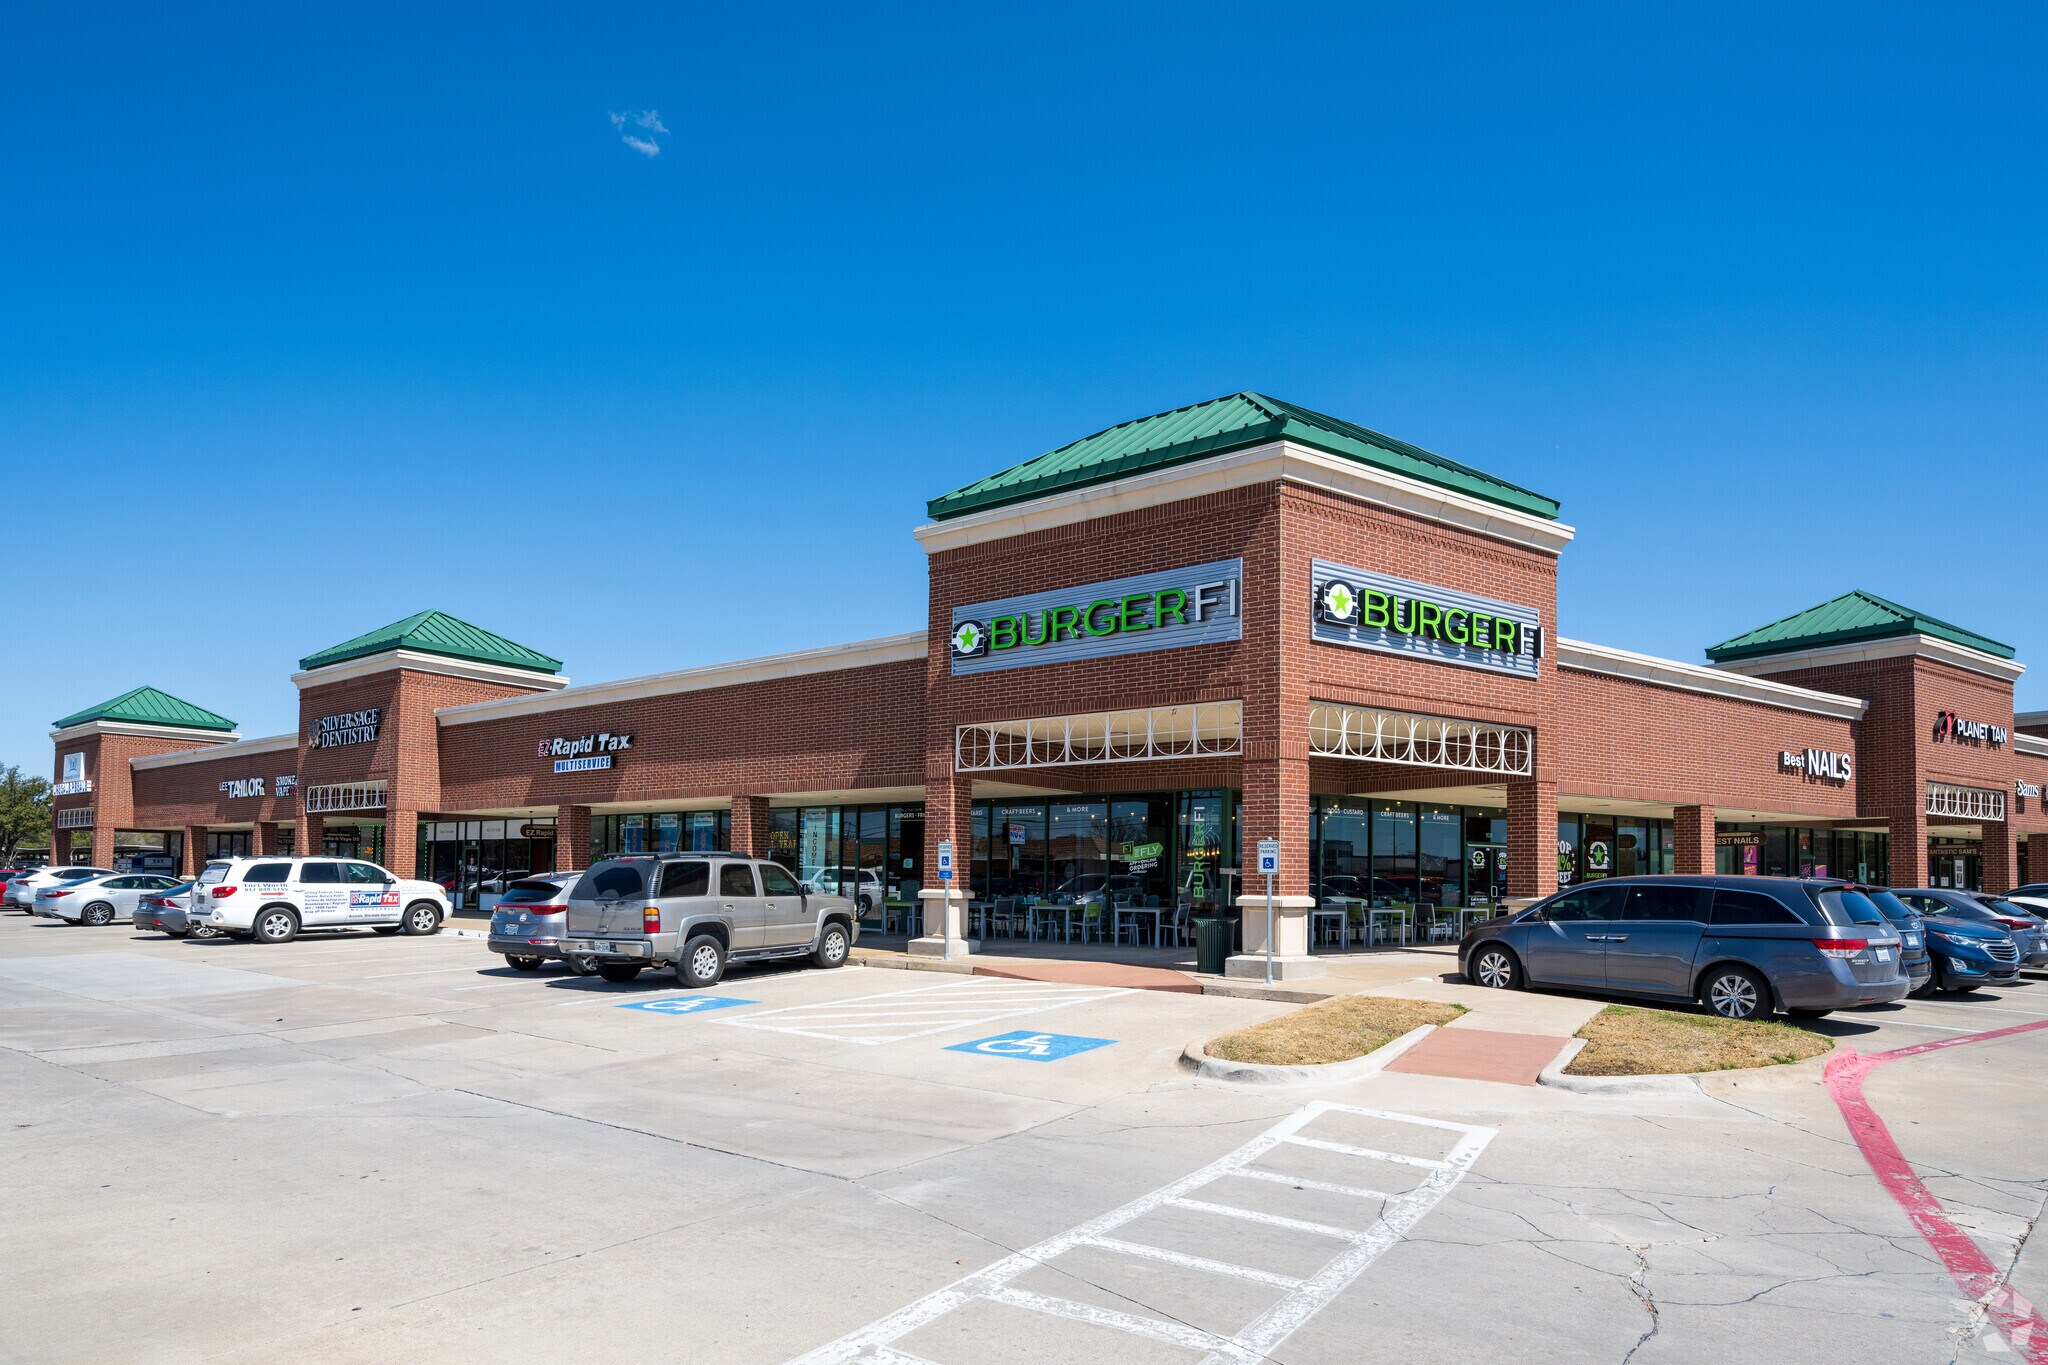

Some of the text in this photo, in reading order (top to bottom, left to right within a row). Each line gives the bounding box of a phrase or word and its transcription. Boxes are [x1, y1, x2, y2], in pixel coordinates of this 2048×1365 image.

[991, 580, 1236, 650] BURGERFI
[1364, 588, 1545, 658] BURGERFI
[322, 708, 378, 732] SILVER SAGE
[322, 725, 377, 748] DENTISTRY
[1957, 718, 2007, 743] PLANET TAN
[598, 733, 630, 751] Tax
[555, 757, 610, 772] MULTISERVICE
[1784, 749, 1852, 780] Best NAILS
[227, 777, 265, 799] TAILOR
[275, 786, 289, 797] VAPE
[2017, 779, 2039, 797] Sams
[1343, 808, 1364, 816] CUSTARD
[536, 829, 554, 837] Rapid
[1733, 836, 1760, 845] NAILS
[1140, 846, 1159, 857] FLY
[1129, 862, 1158, 872] ORDERING
[359, 893, 381, 906] Rapid
[382, 894, 398, 903] Tax
